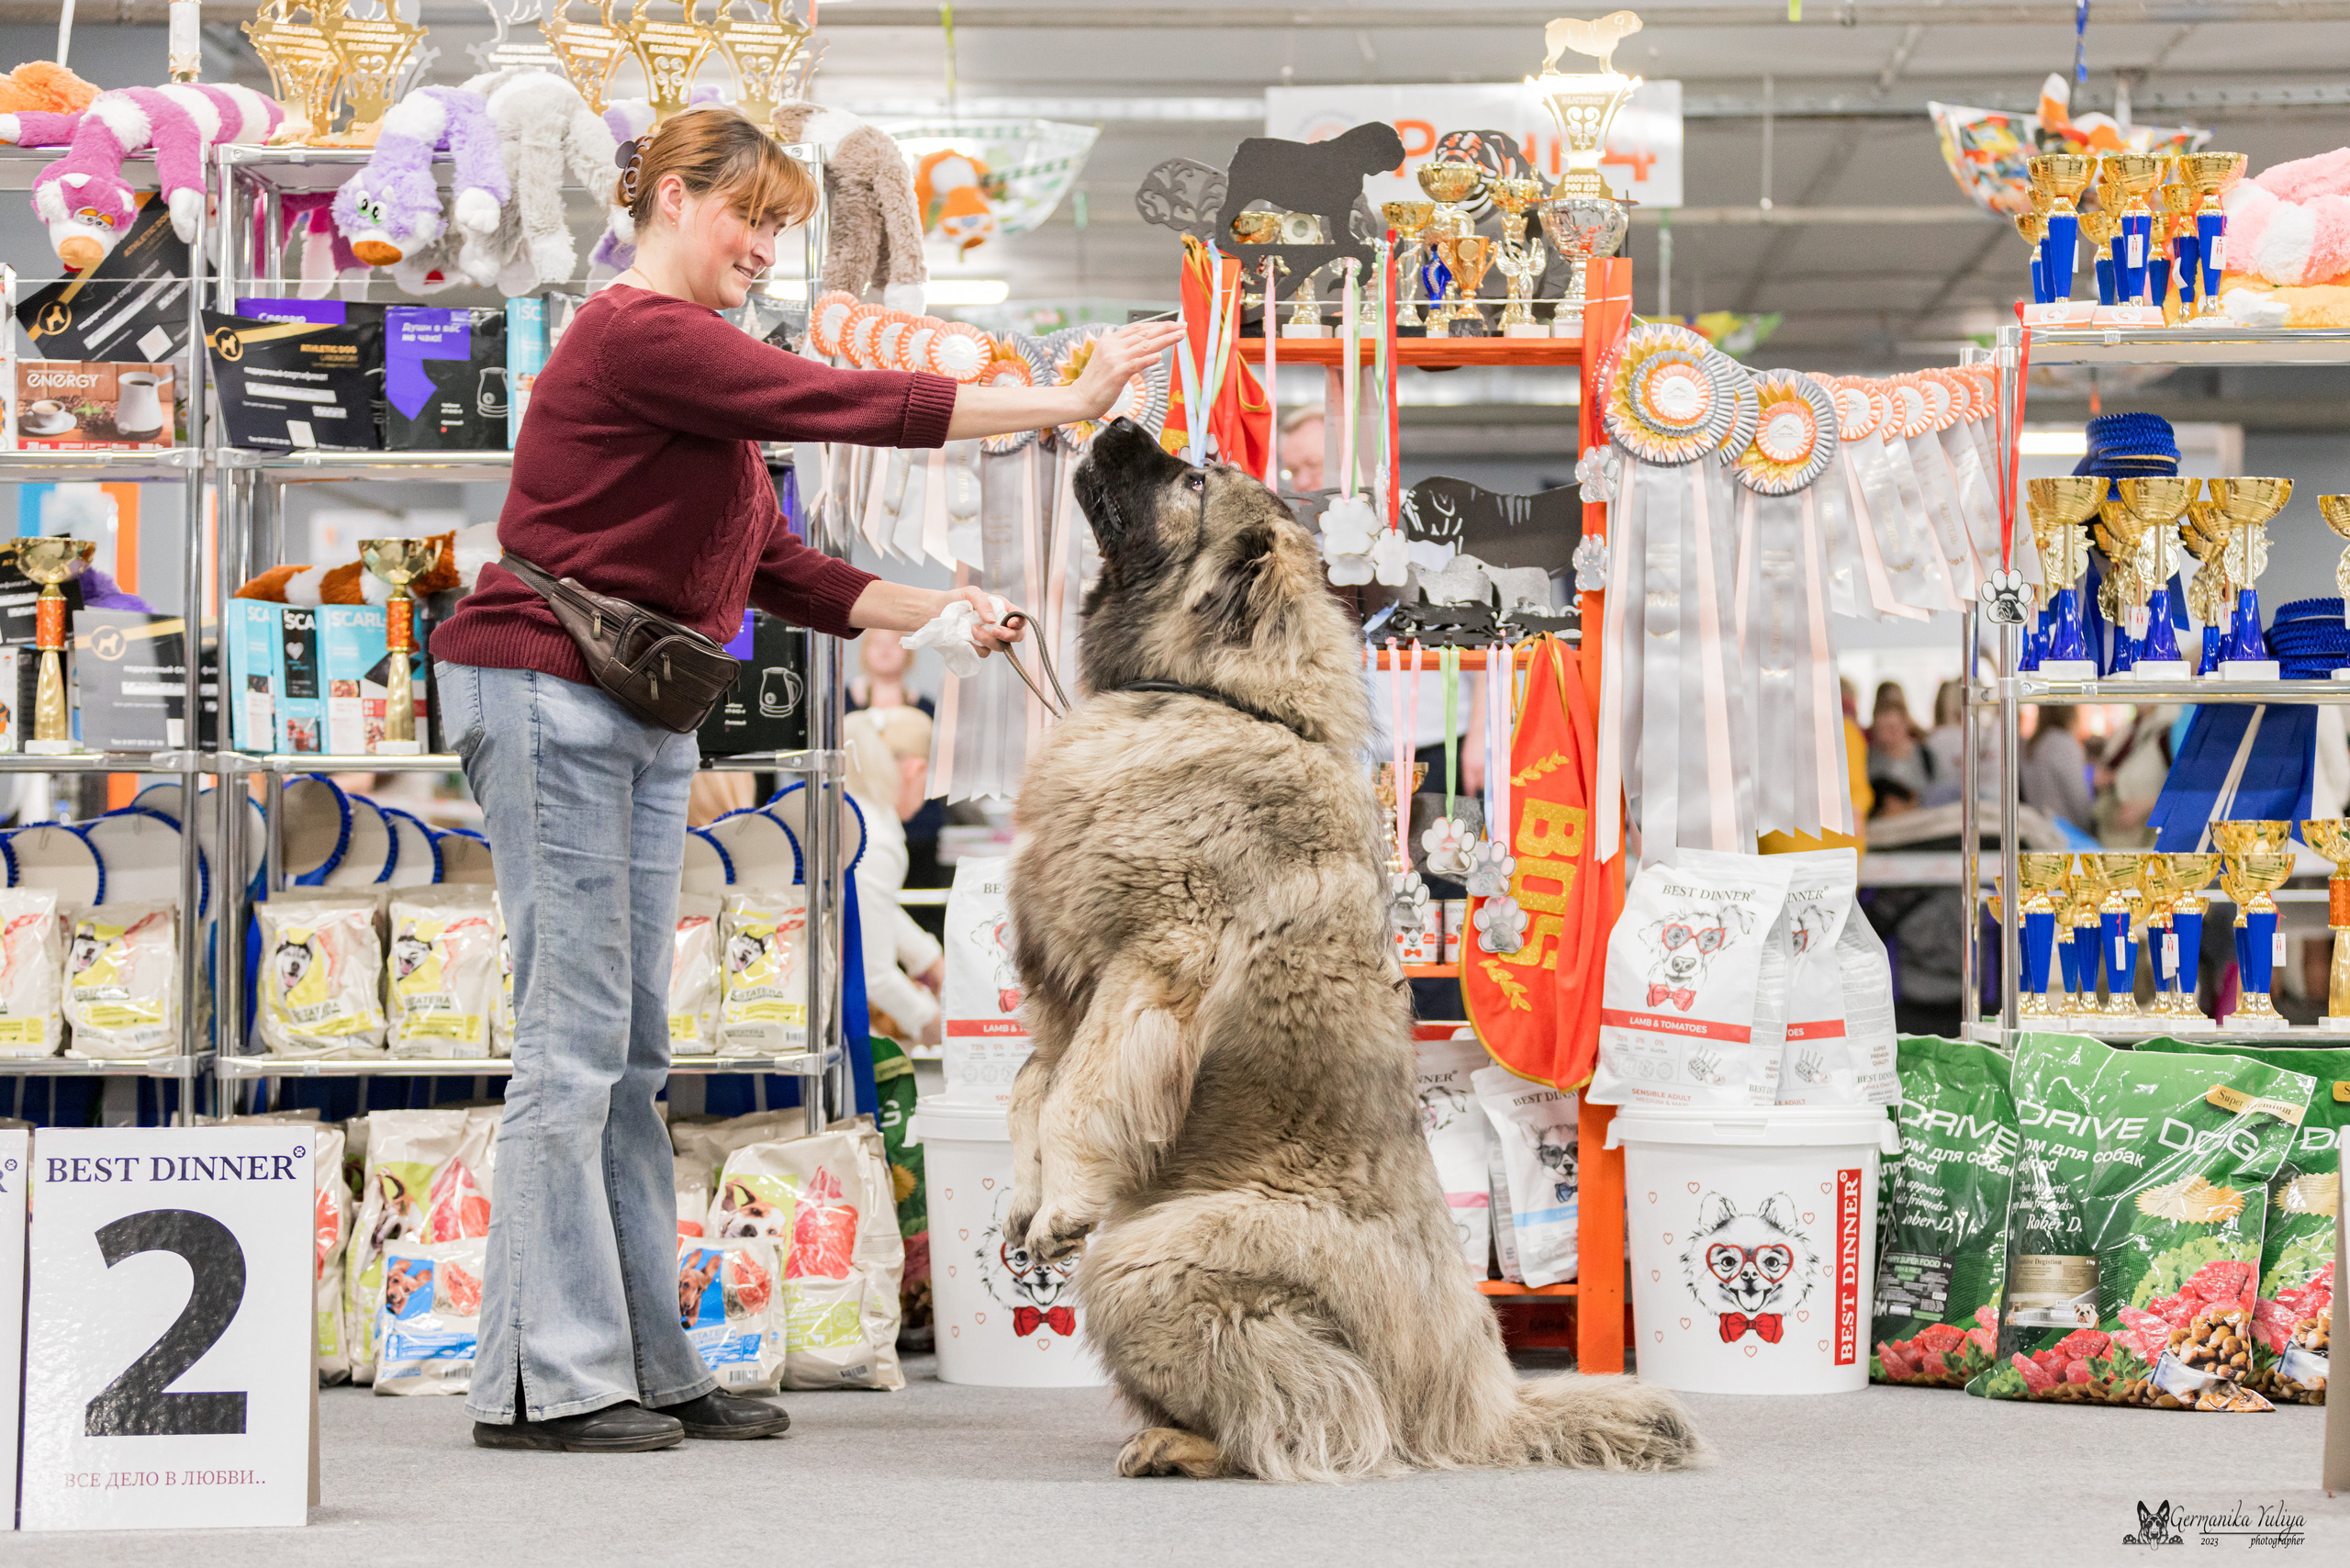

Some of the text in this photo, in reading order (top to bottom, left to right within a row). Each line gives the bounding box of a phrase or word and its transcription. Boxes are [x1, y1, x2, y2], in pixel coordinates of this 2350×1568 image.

[1564, 174, 1601, 184] МОСКВА
[1498, 797, 1588, 970] BOS
[1662, 884, 1751, 902] BEST DINNER
[1787, 890, 1824, 903] INNER
[983, 1025, 1009, 1033] LAMB
[1629, 1015, 1708, 1035] LAMB & TOMATOES
[1857, 1070, 1896, 1084] BEST DINNE
[1513, 1092, 1543, 1107] BEST
[1631, 1088, 1692, 1102] SENSIBLE ADULT
[2217, 1089, 2244, 1107] Super
[1898, 1098, 2020, 1157] DRIVE
[2018, 1099, 2260, 1162] DRIVE DOG
[1928, 1147, 1964, 1163] для
[1966, 1150, 2014, 1177] соба
[2048, 1143, 2089, 1162] для
[2092, 1147, 2146, 1169] собак
[46, 1154, 297, 1183] BEST DINNER
[1907, 1179, 1945, 1197] appetit
[2026, 1213, 2083, 1233] Rober D.
[1841, 1177, 1859, 1362] BEST DINNER
[1900, 1256, 1919, 1265] SUPER
[1919, 1258, 1941, 1268] FOOD
[84, 1208, 248, 1437] 2
[64, 1469, 266, 1490] ВСЕ ДЕЛО В ЛЮБВИ..
